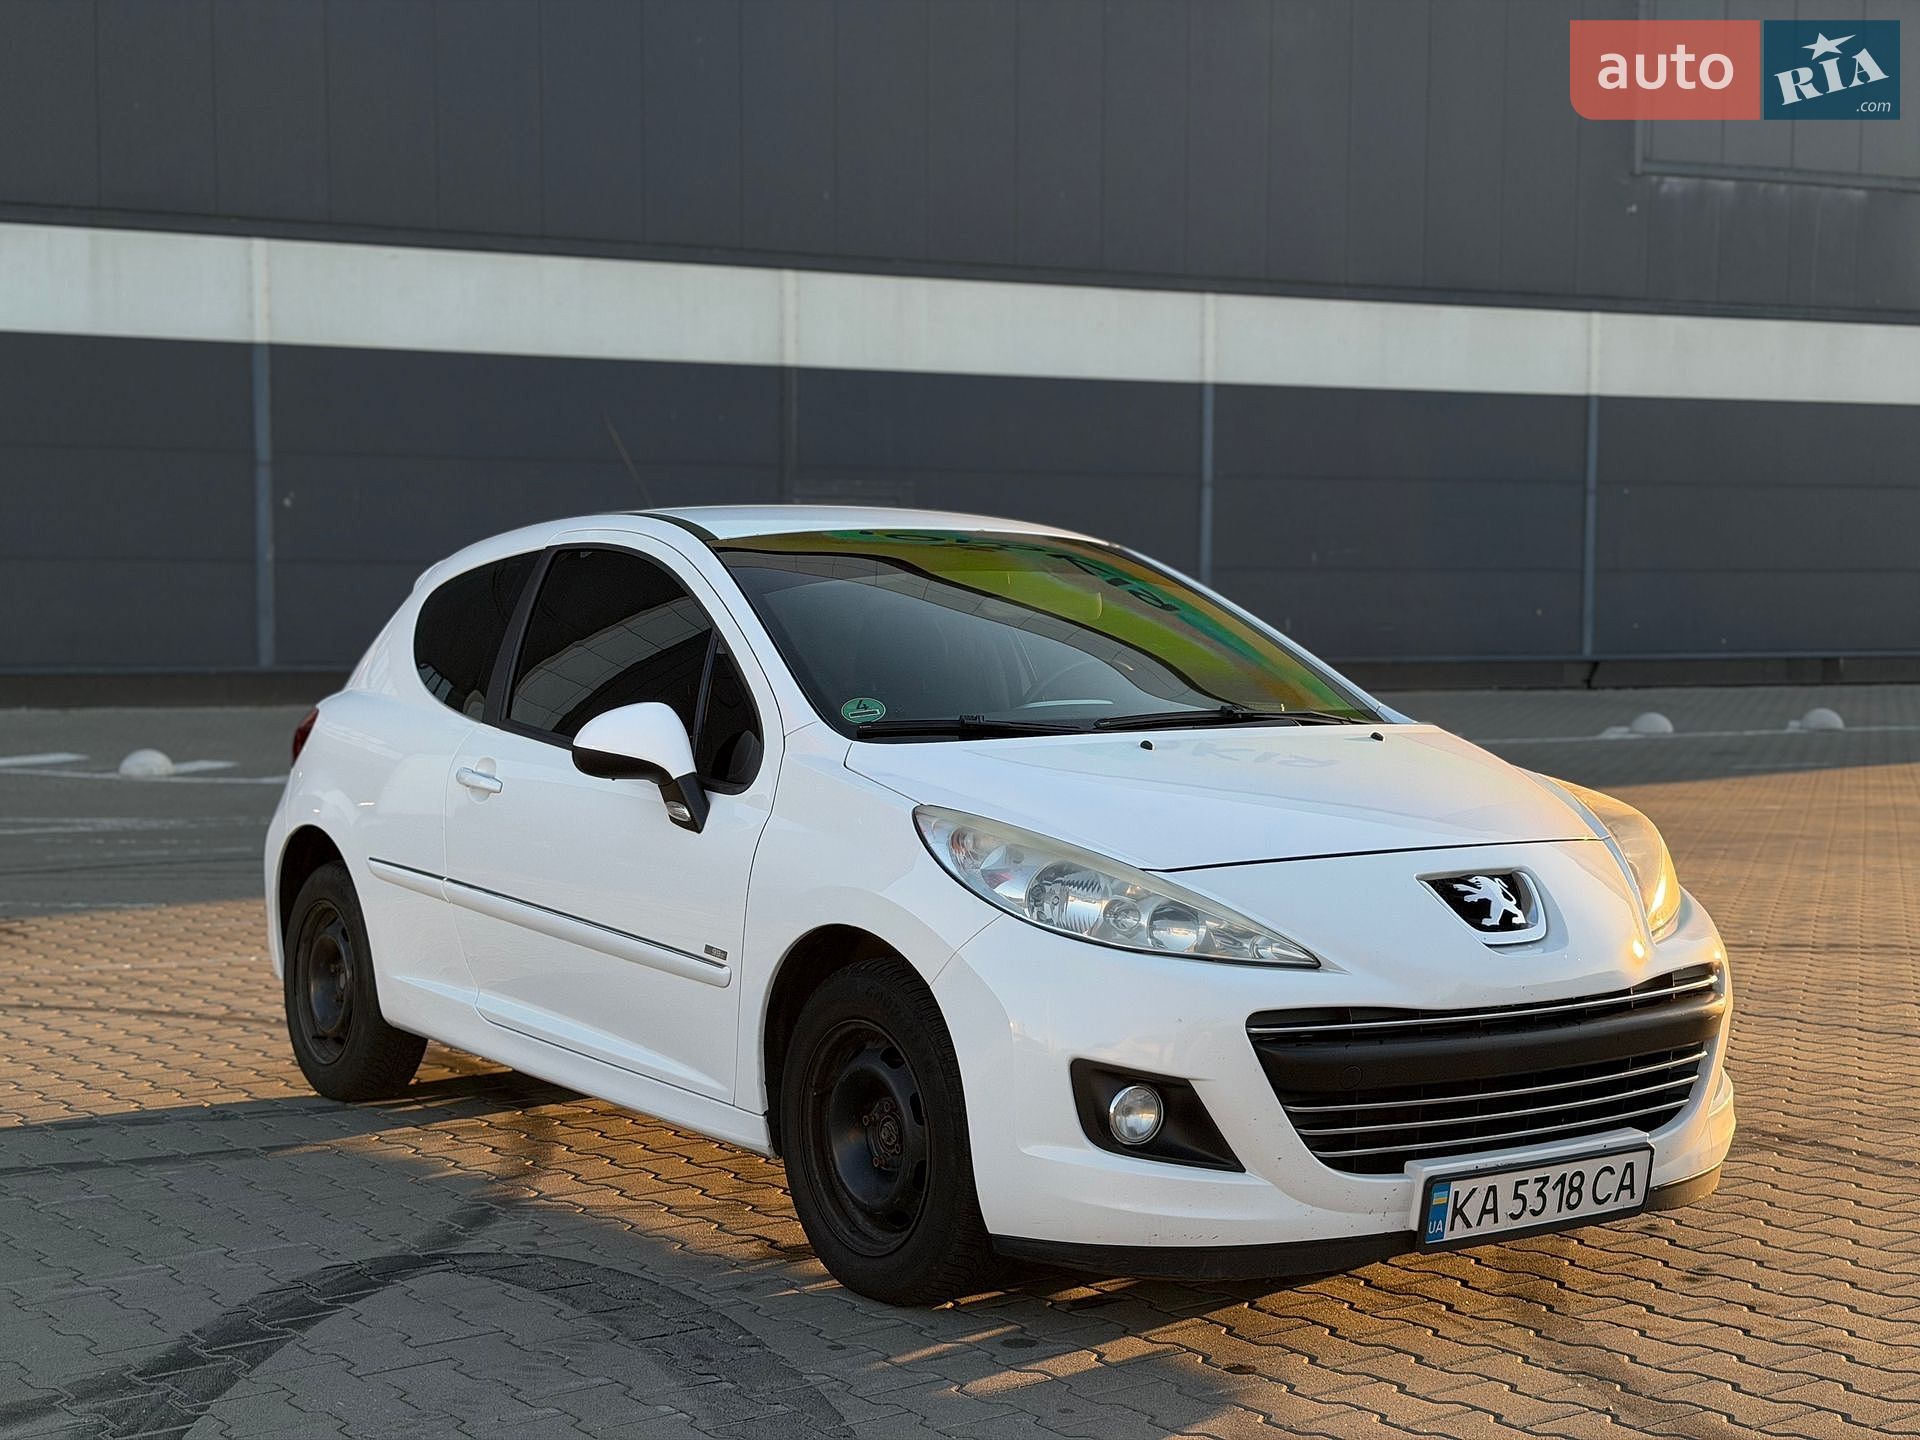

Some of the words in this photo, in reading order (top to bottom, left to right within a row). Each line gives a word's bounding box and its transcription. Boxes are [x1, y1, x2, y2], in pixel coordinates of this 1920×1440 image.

[856, 699, 869, 710] 4
[1449, 1184, 1500, 1232] KA
[1508, 1170, 1586, 1220] 5318
[1592, 1161, 1636, 1206] CA
[1428, 1219, 1444, 1235] UA
